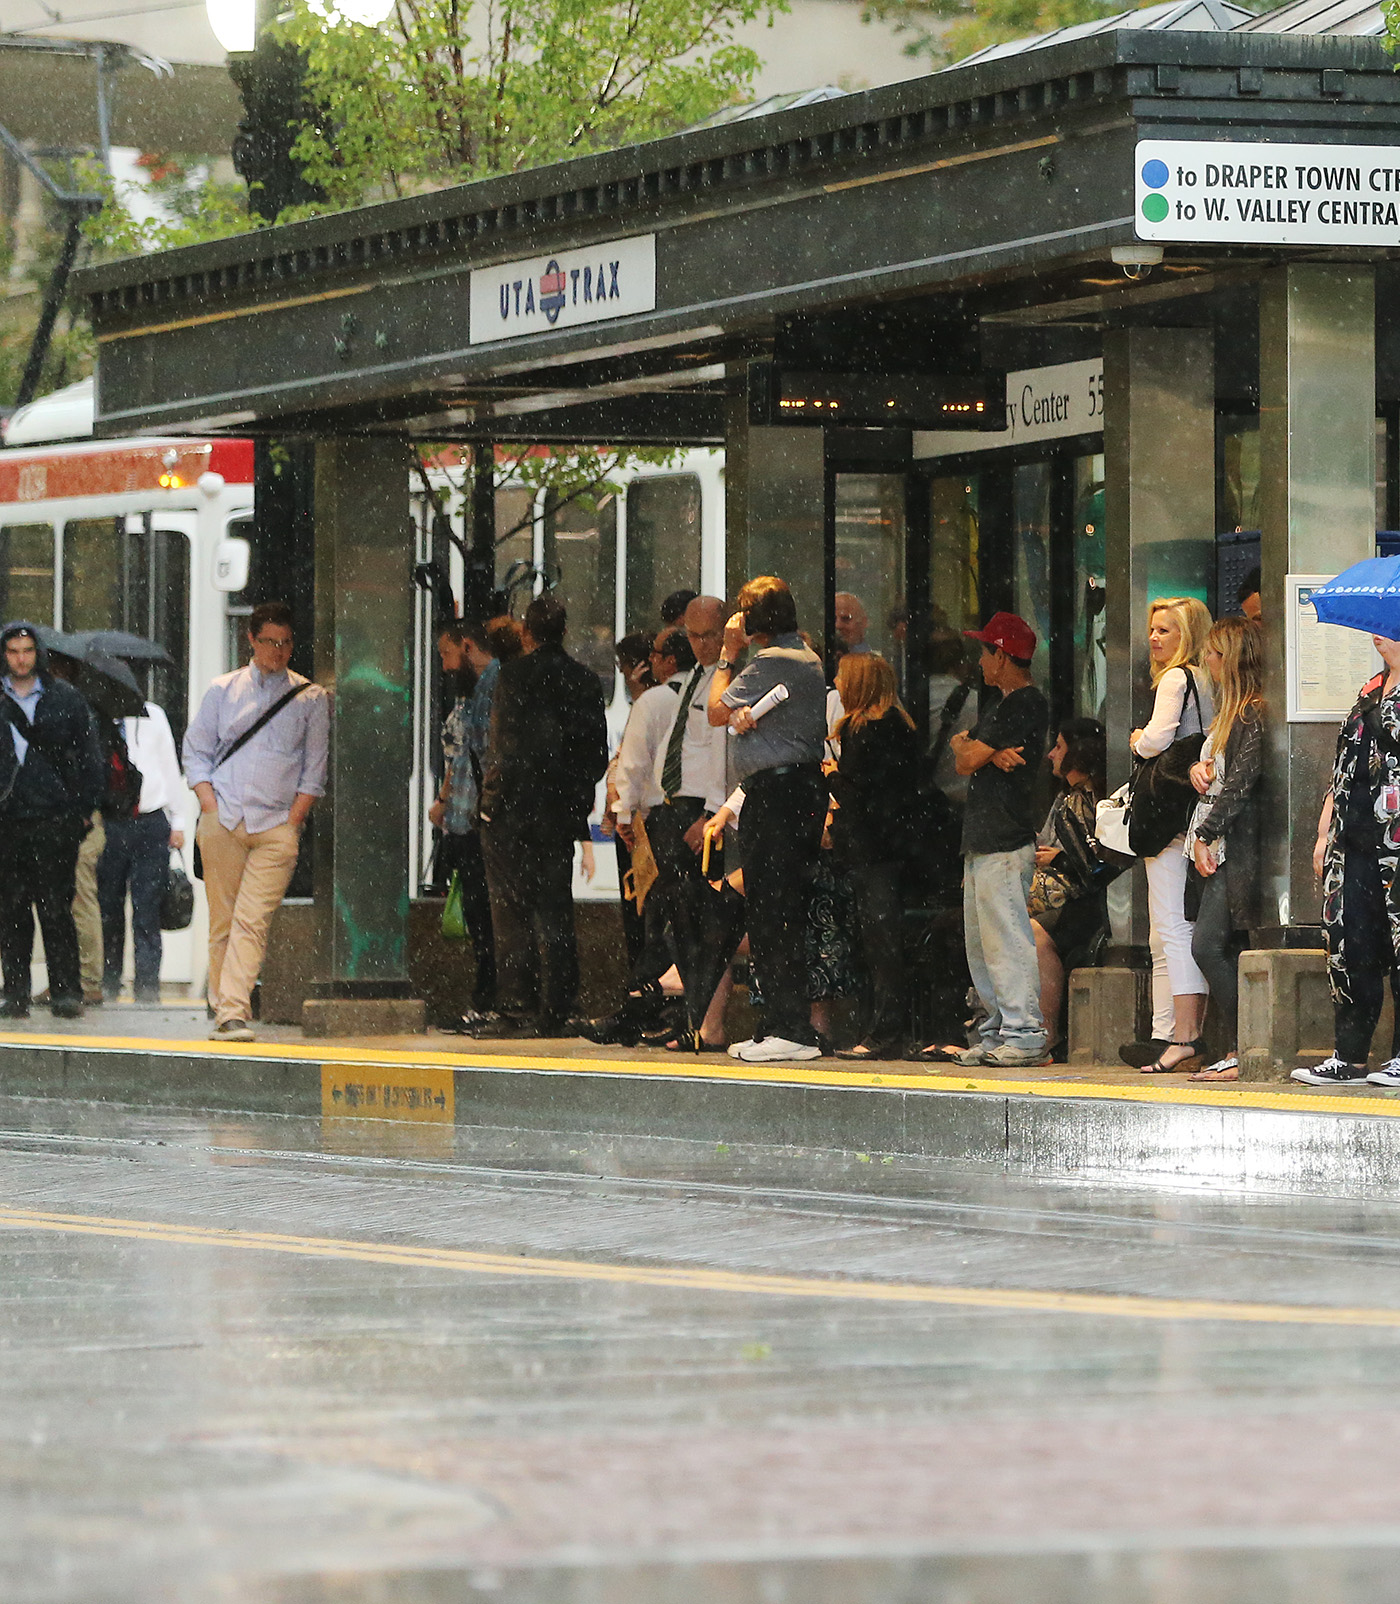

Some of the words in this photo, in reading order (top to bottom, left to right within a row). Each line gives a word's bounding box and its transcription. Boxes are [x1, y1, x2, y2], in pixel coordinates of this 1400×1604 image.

[1177, 166, 1197, 187] to
[1205, 164, 1288, 189] DRAPER
[1295, 166, 1361, 192] TOWN
[1176, 200, 1196, 221] to
[1204, 198, 1230, 222] W.
[1237, 198, 1311, 224] VALLEY
[500, 278, 536, 320] UTA
[570, 260, 620, 306] TRAX
[1022, 384, 1070, 427] Center
